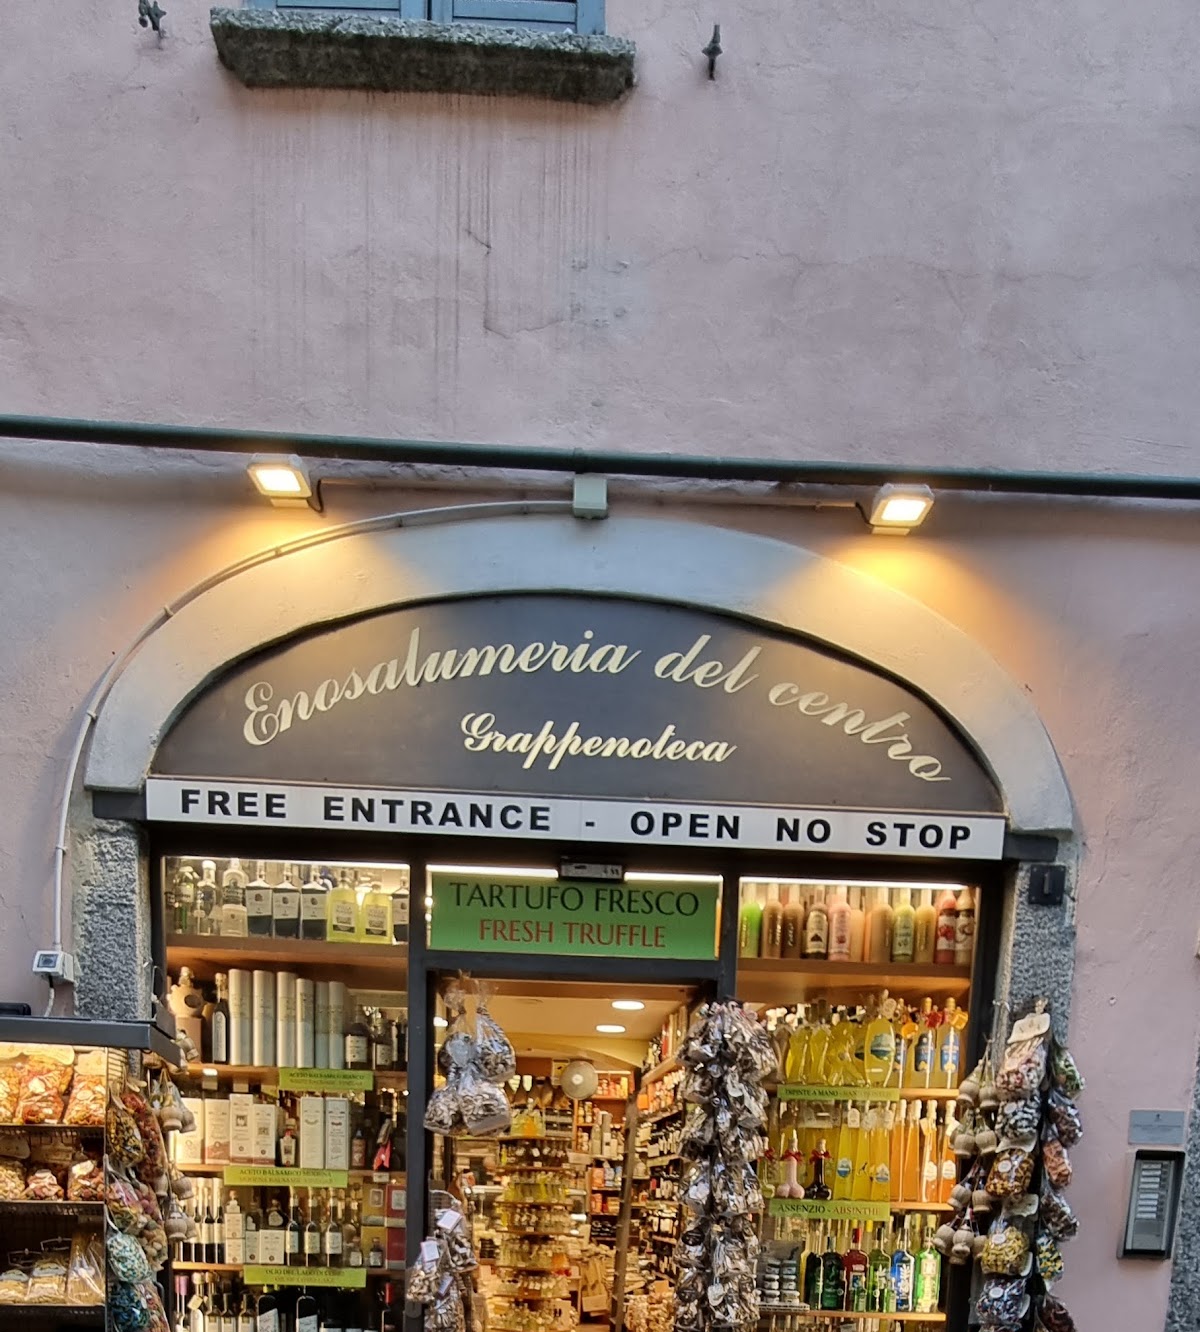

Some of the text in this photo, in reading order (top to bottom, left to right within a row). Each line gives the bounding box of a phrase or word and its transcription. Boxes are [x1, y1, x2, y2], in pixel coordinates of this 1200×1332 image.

[243, 627, 952, 782] Enosalumeria del centro
[460, 712, 737, 770] Grappenoteca
[181, 788, 287, 819] FREE
[323, 796, 551, 832] ENTRANCE
[630, 810, 740, 841] OPEN
[776, 818, 832, 843] NO
[866, 821, 972, 850] STOP
[450, 882, 700, 917] TARTUFO FRESCO
[479, 919, 667, 948] FRESH TRUFFLE
[778, 1204, 825, 1214] ASSENZIO
[833, 1206, 880, 1216] ABSINTHE
